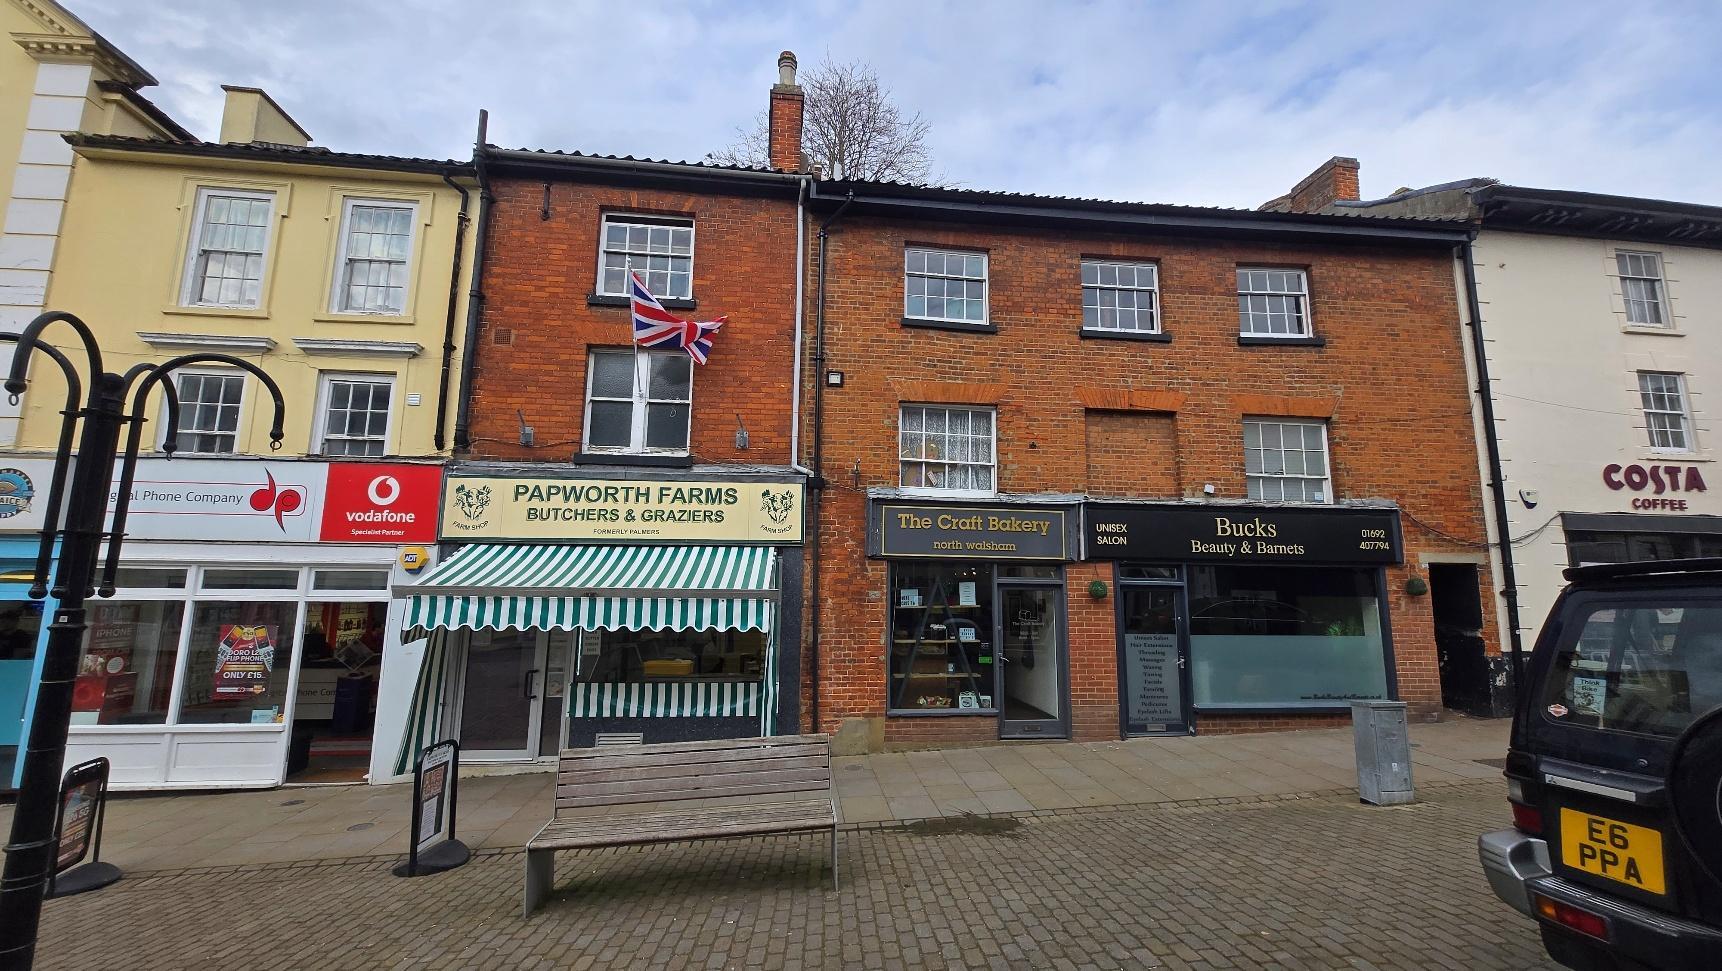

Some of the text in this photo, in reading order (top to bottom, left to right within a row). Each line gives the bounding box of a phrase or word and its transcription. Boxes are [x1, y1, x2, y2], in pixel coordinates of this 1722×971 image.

[1603, 463, 1708, 495] COSTA
[143, 490, 182, 502] Phone
[186, 491, 243, 505] Company
[513, 484, 739, 506] PAPWORTH FARMS
[1632, 498, 1688, 511] COFFEE
[346, 509, 415, 523] vodafone
[526, 507, 725, 523] BUTCHERS & GRAZIERS
[452, 520, 489, 531] FARM SHOP
[898, 513, 1050, 536] The Craft Bakery
[1096, 523, 1128, 534] UNISEX
[1215, 517, 1277, 538] Bucks
[351, 528, 381, 536] Specialist
[1361, 529, 1385, 539] 01692
[933, 539, 1017, 552] north walsham
[1096, 535, 1127, 546] SALON
[1359, 540, 1390, 551] 407794
[1190, 539, 1305, 557] Beauty & Barnets
[404, 554, 417, 562] ADT
[223, 671, 246, 679] ONLY
[1588, 818, 1629, 851] E6
[1579, 843, 1643, 885] PPA
